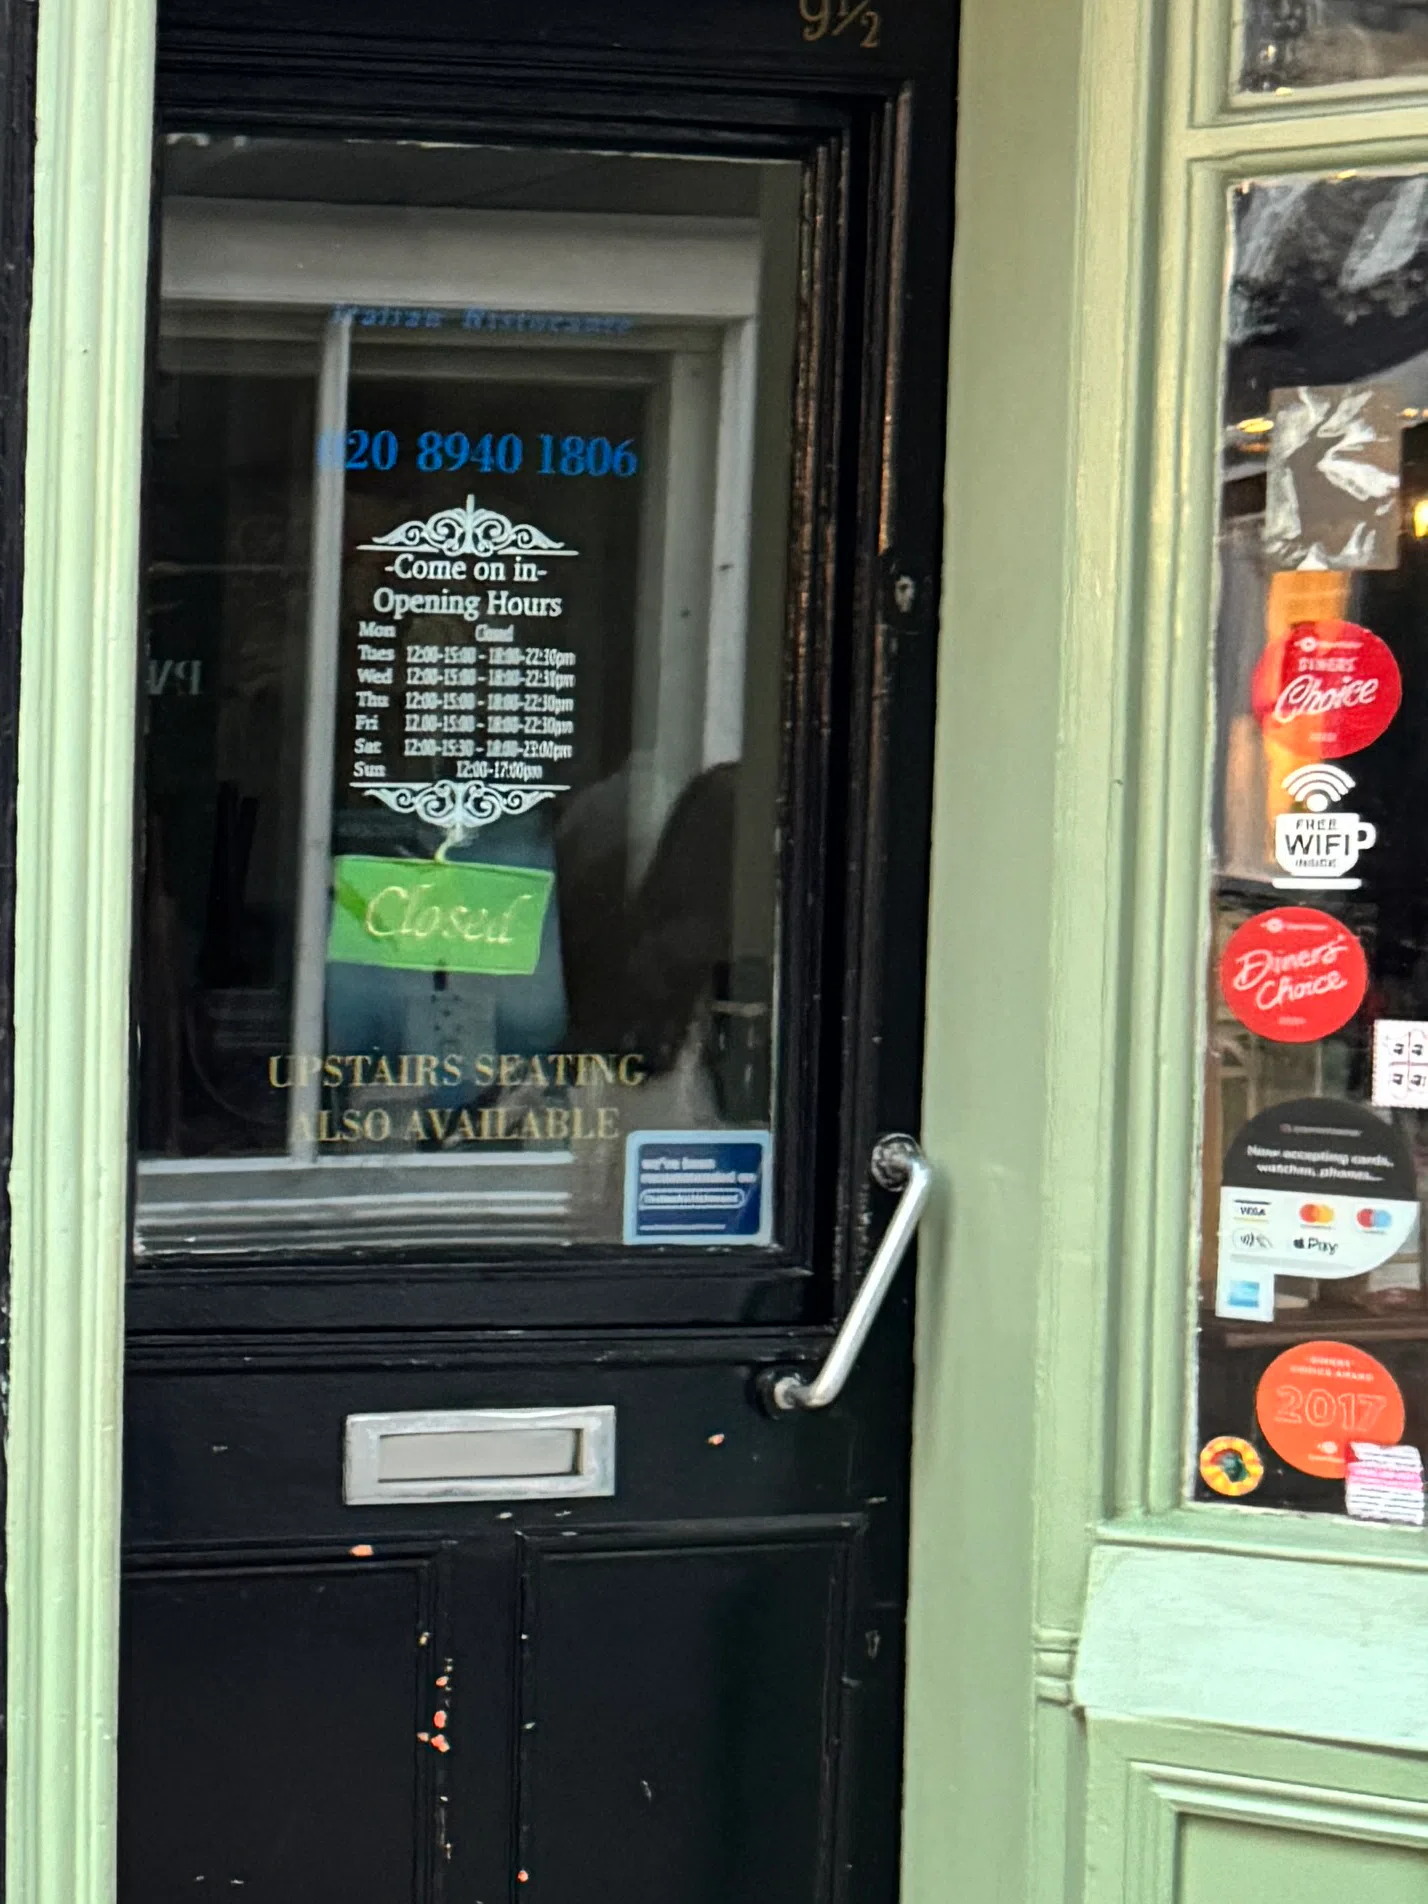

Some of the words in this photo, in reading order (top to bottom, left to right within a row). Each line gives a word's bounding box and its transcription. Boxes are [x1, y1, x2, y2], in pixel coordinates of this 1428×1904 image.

[416, 430, 524, 473] 8940
[537, 433, 639, 478] 1806
[473, 561, 506, 582] on
[373, 587, 481, 621] Opening
[487, 590, 563, 617] Hours
[358, 621, 397, 638] Mon
[357, 645, 395, 661] Tues
[357, 668, 393, 684] Wed
[356, 691, 390, 707] Thu
[1274, 674, 1380, 724] Choice
[355, 714, 379, 731] Fri
[354, 738, 382, 754] Sat
[353, 761, 386, 778] Sun
[1296, 818, 1339, 831] FREE
[1285, 834, 1351, 857] WIFI
[365, 883, 533, 944] Closed
[1255, 970, 1348, 1011] Choice
[268, 1054, 463, 1089] UPSTAIRS
[474, 1053, 645, 1087] SEATING
[404, 1107, 621, 1141] AVAILABLE
[1240, 1207, 1266, 1216] VISA
[1308, 1237, 1338, 1255] Pay
[1273, 1384, 1387, 1432] 2017
